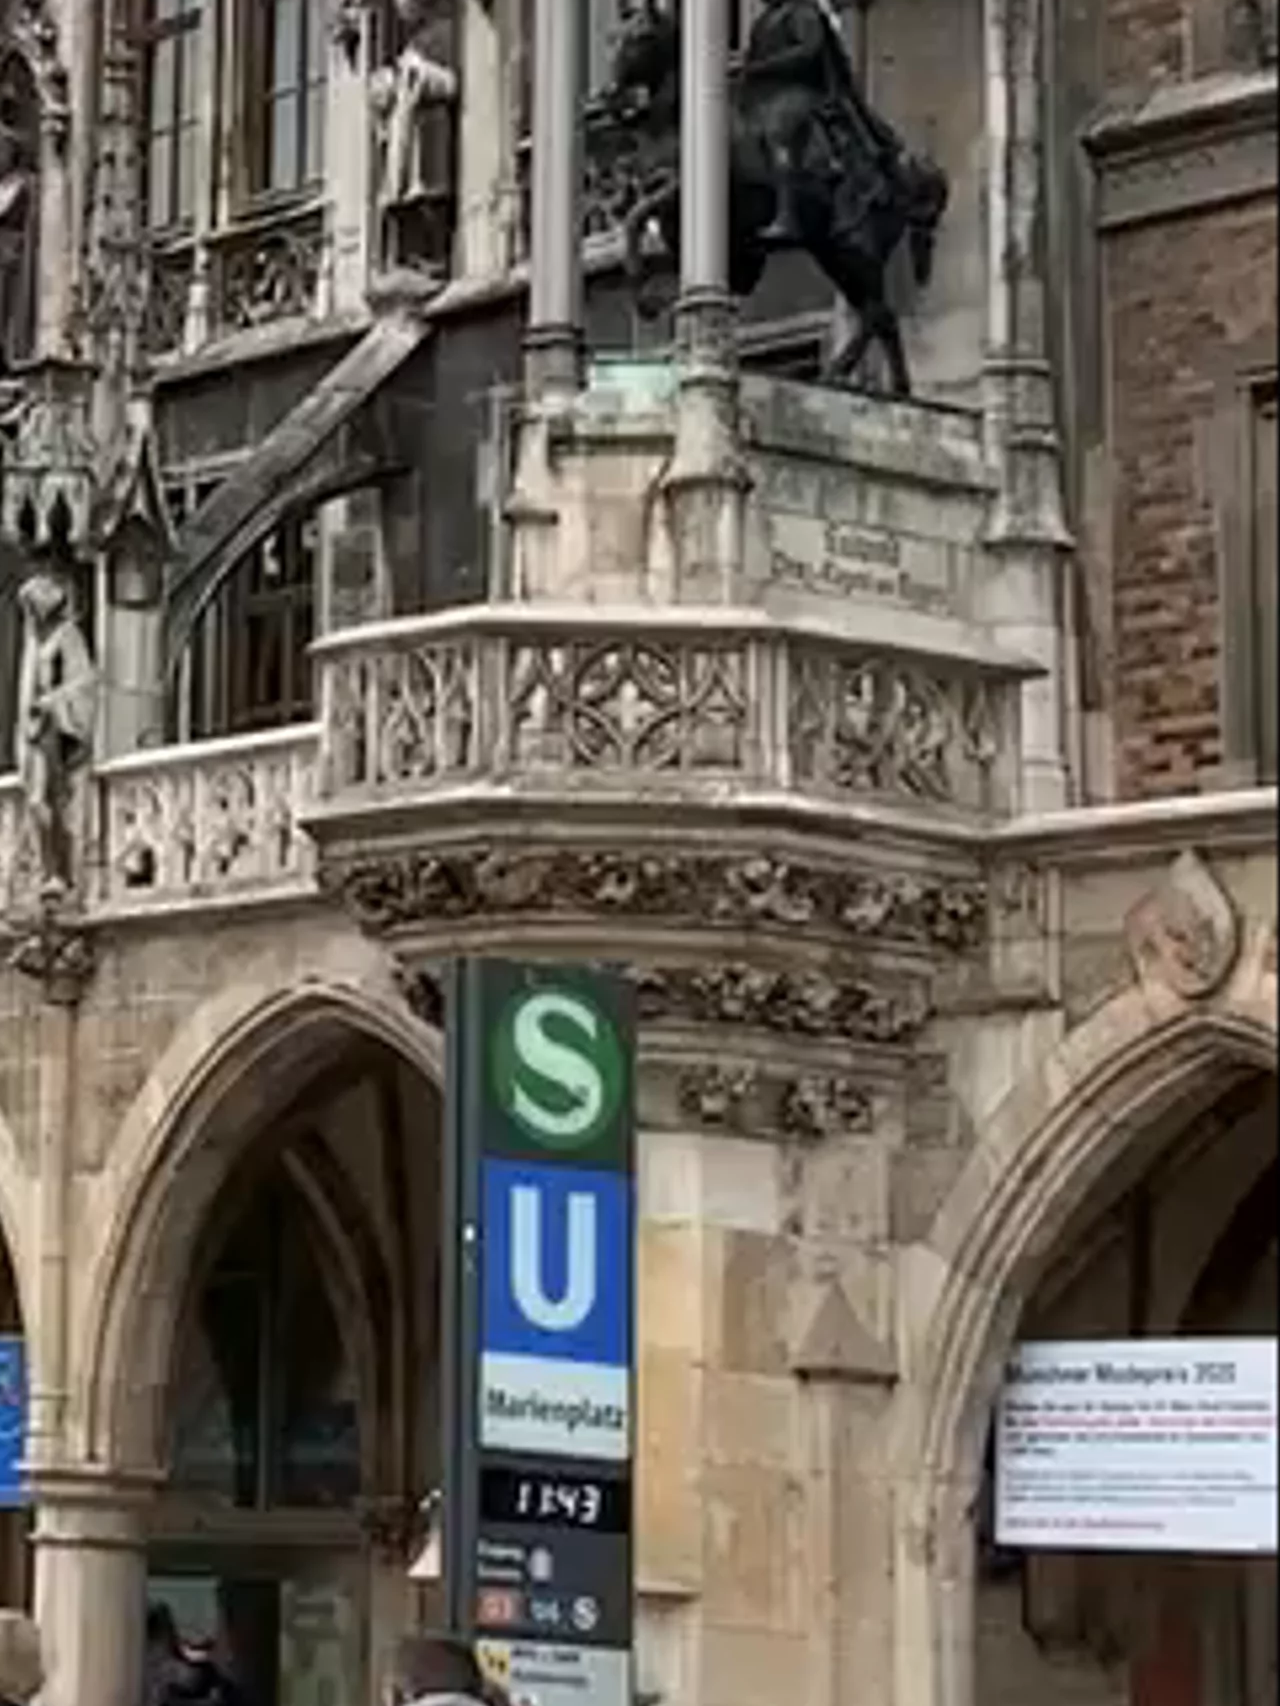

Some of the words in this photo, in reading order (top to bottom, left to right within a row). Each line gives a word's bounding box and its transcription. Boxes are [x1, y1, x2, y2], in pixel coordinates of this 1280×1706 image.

[510, 992, 603, 1135] S
[509, 1185, 596, 1331] U
[487, 1388, 626, 1432] Marienplatz
